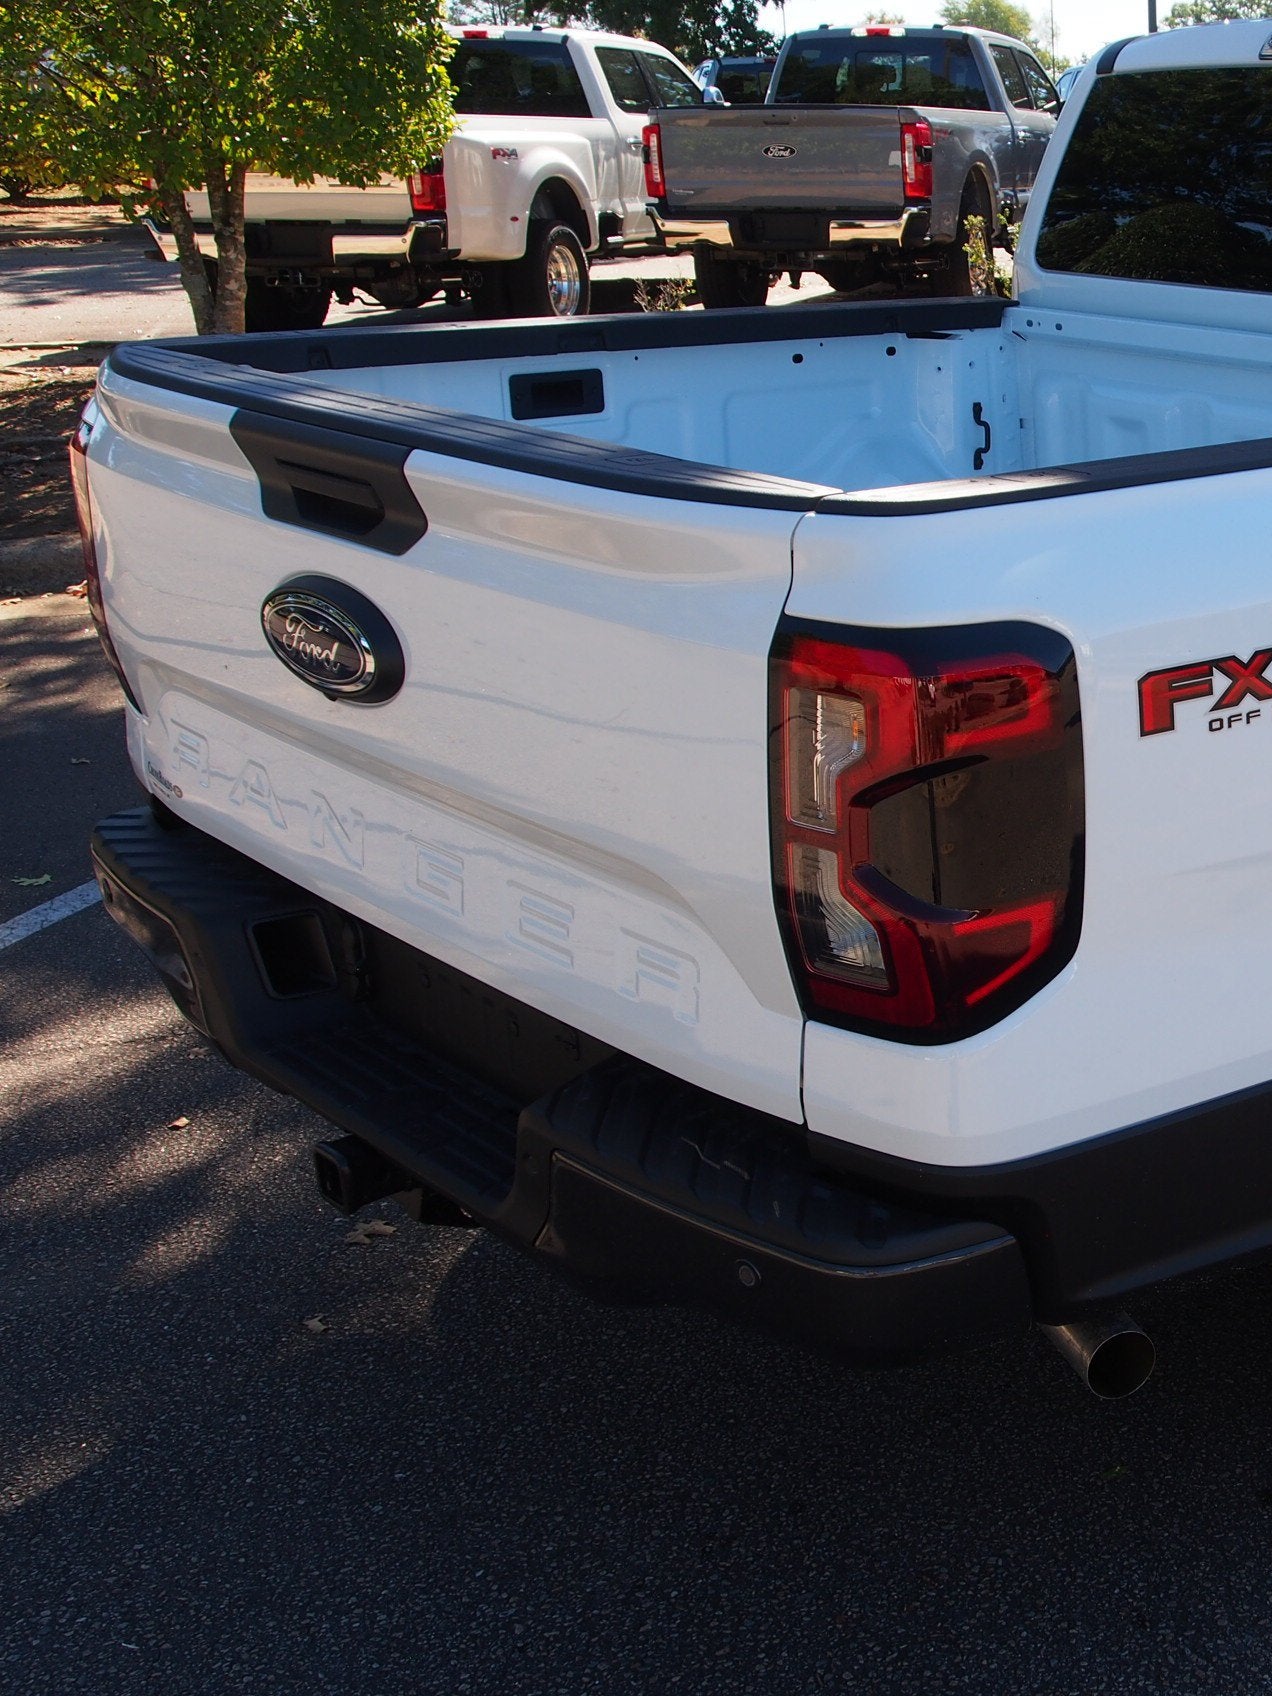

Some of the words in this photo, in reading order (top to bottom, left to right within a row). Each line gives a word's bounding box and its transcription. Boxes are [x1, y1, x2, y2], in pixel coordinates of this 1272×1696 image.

[767, 145, 791, 157] Ford
[282, 613, 340, 671] Ford
[1208, 708, 1262, 733] OFF
[168, 718, 702, 1026] RANGER
